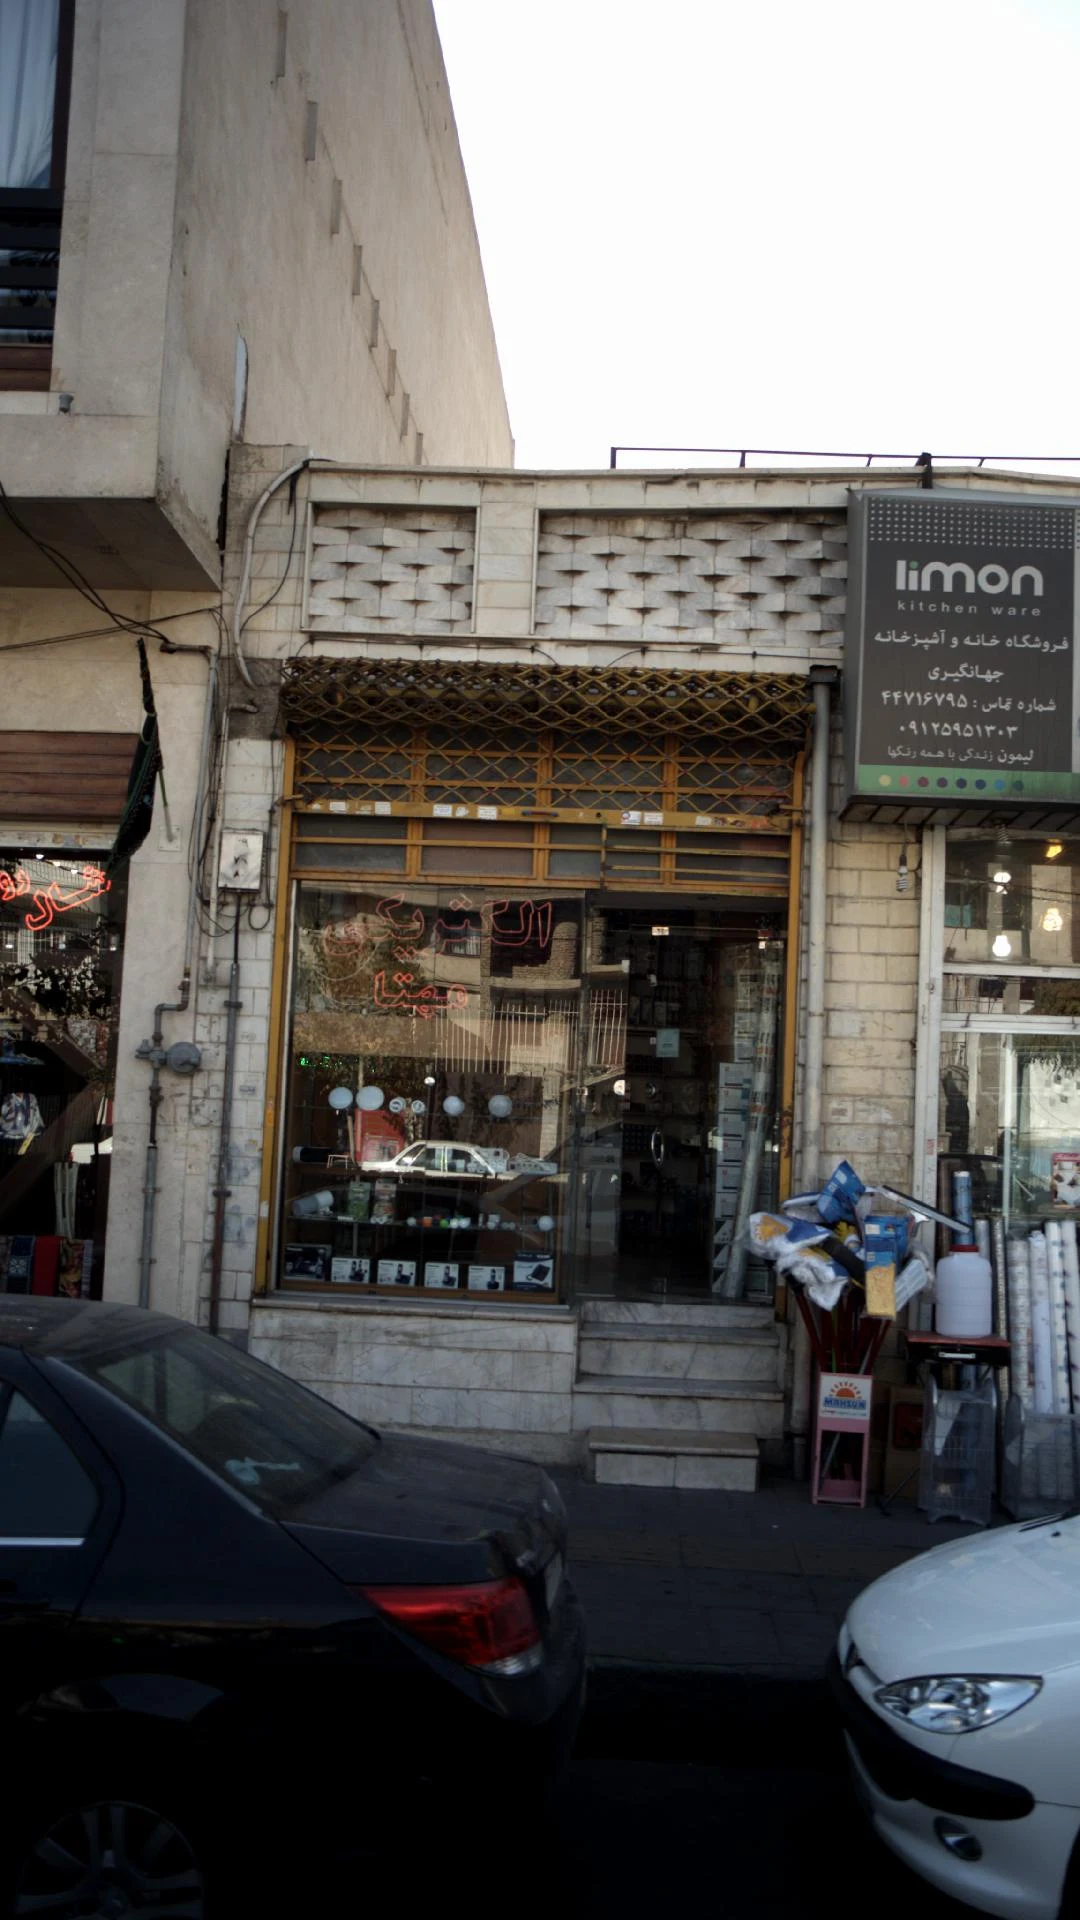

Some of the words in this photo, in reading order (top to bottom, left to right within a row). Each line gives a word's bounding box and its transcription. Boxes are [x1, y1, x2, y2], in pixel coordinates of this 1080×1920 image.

[896, 559, 1044, 596] limon
[898, 600, 978, 614] kitchen
[992, 606, 1041, 616] ware
[874, 630, 946, 651] آشپزخانه
[951, 637, 959, 648] و
[964, 634, 1000, 647] خانه
[1005, 634, 1069, 652] فروشگاه
[928, 663, 1004, 683] جهانگیری
[881, 691, 968, 709] ۴۴۷۱۶۷۹۵
[982, 697, 1013, 713] تماس
[1018, 698, 1057, 713] شماره
[899, 721, 1019, 738] ۰۹۱۲۵۹۵۱۳۰۳
[920, 749, 944, 758] همه
[948, 748, 955, 760] با
[959, 748, 993, 761] زندگی
[998, 749, 1034, 765] لیمون
